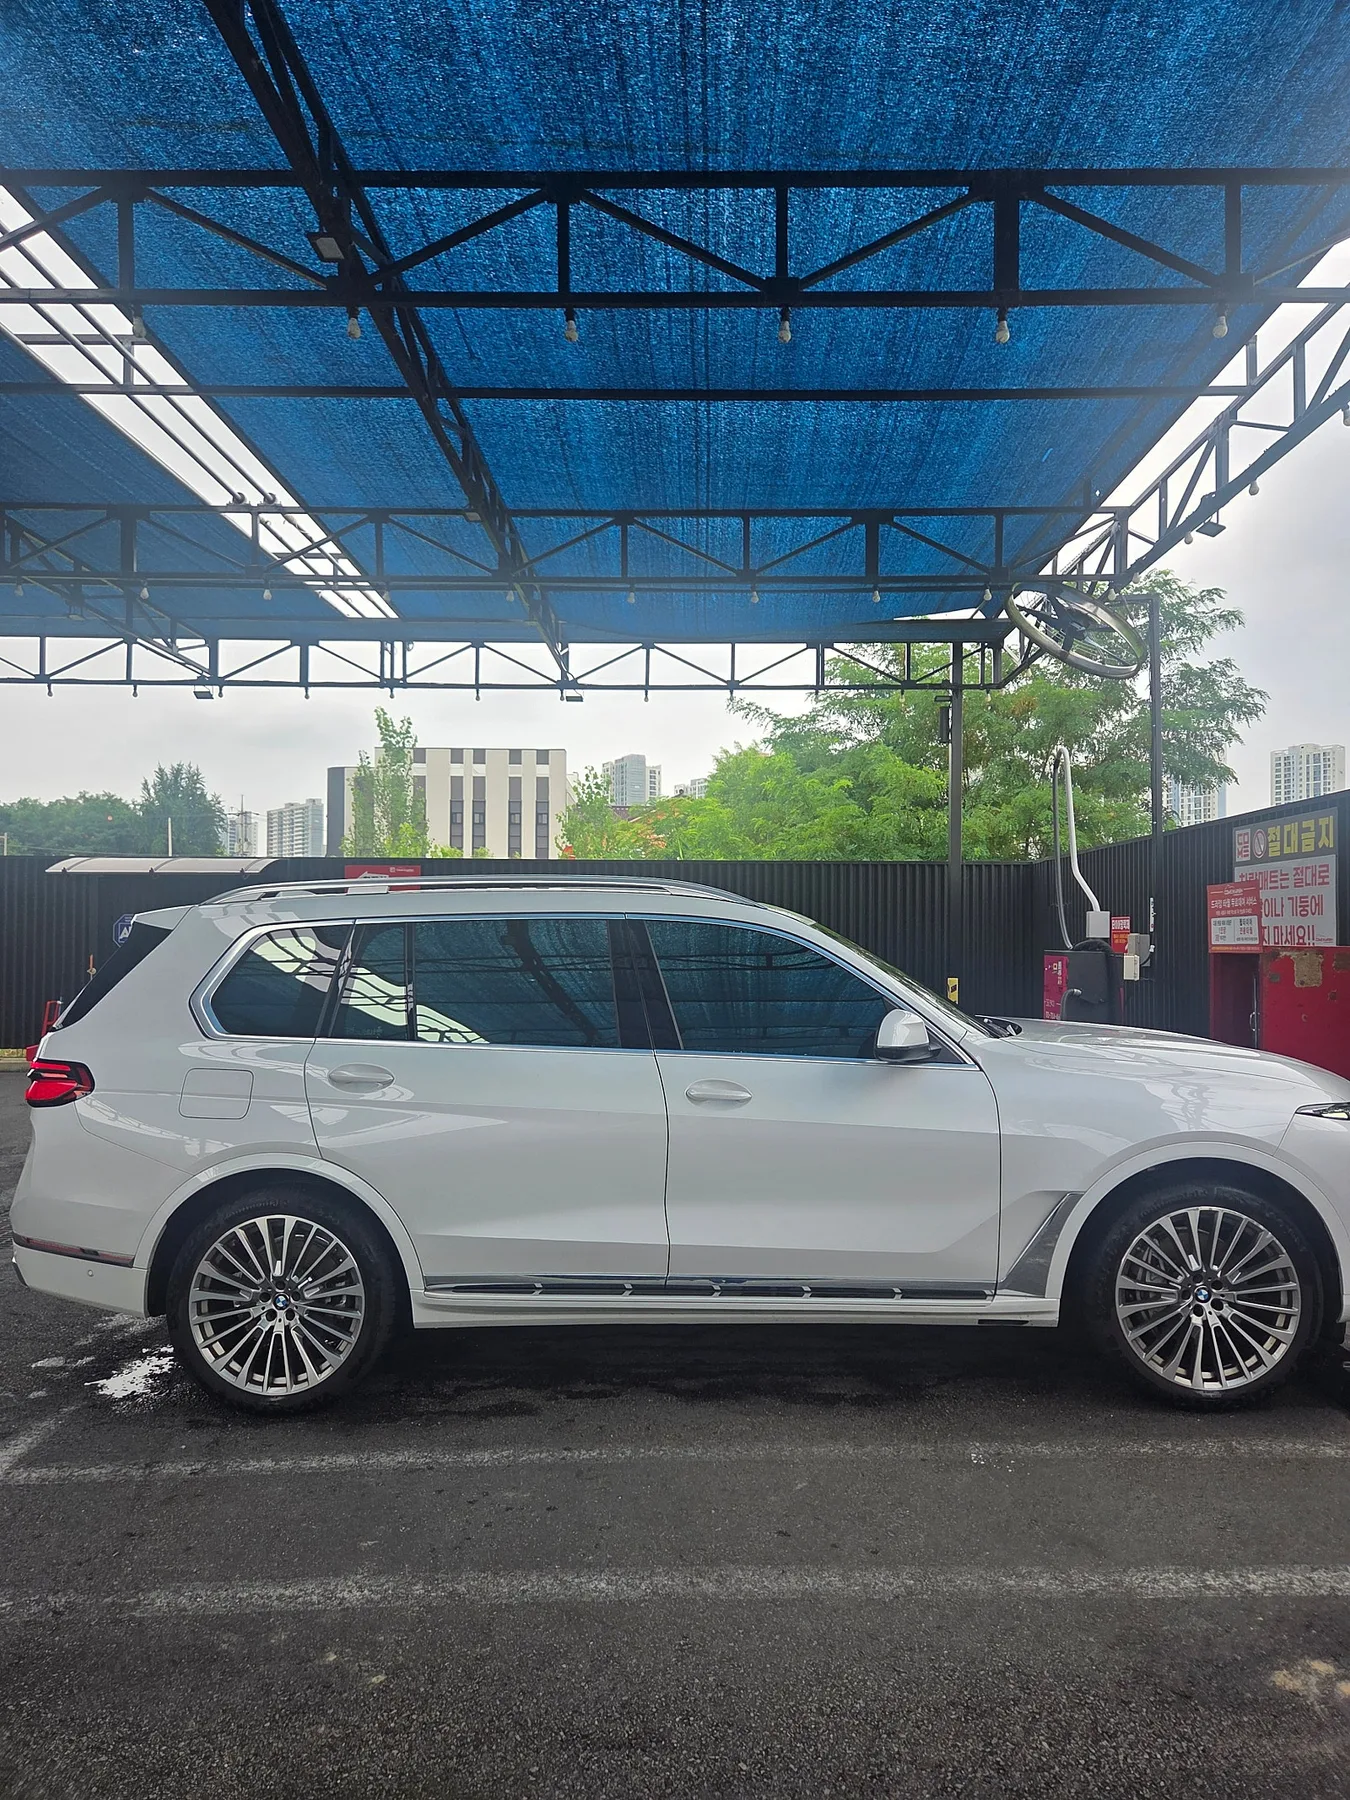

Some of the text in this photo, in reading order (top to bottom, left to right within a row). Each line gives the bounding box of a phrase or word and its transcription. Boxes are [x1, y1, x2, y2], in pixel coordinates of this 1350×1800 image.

[1267, 815, 1334, 857] 절대금지
[1293, 863, 1330, 888] 절대로
[1287, 894, 1324, 918] 기둥에
[1273, 925, 1315, 946] 마세요!!
